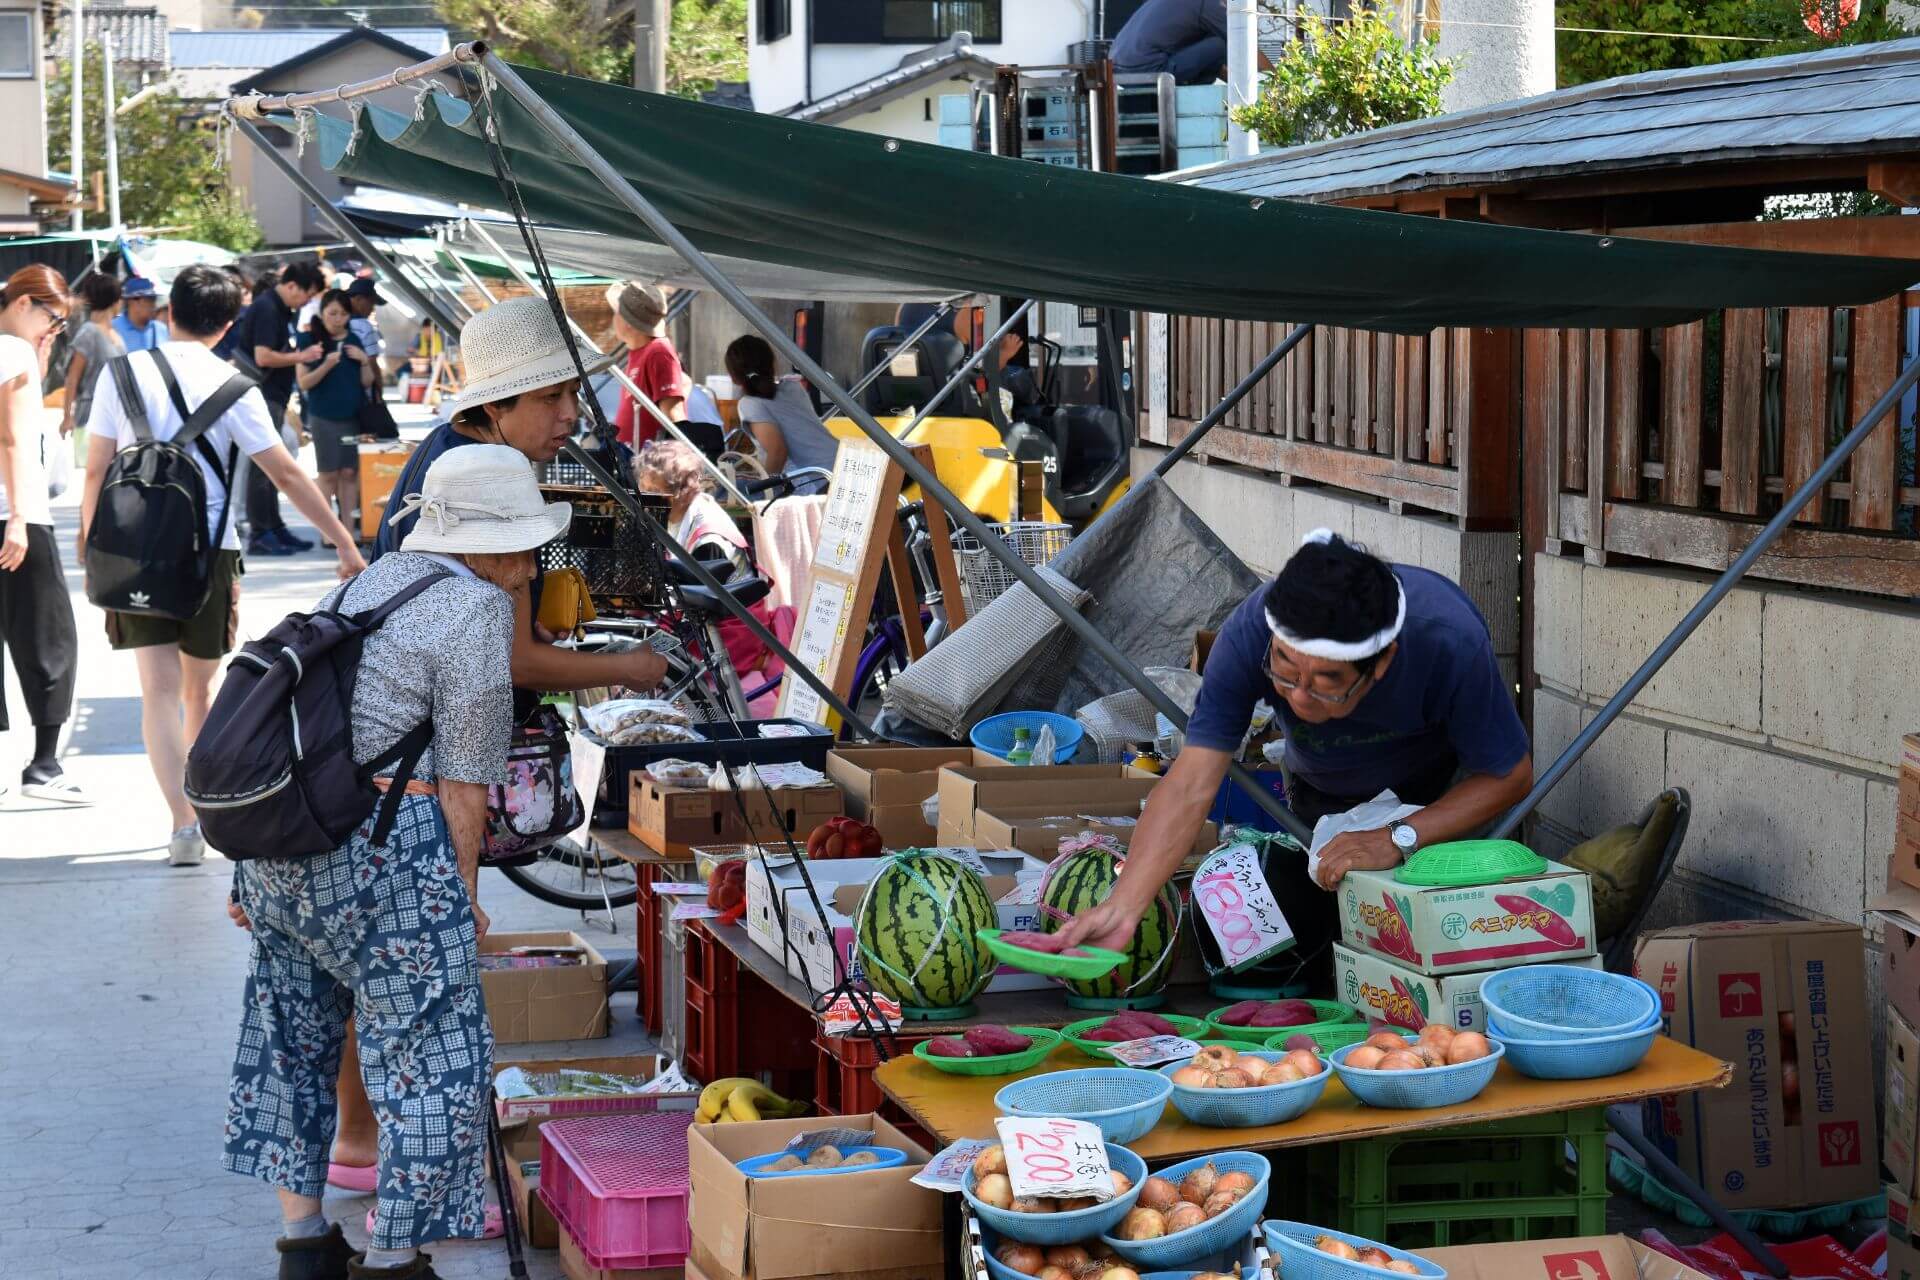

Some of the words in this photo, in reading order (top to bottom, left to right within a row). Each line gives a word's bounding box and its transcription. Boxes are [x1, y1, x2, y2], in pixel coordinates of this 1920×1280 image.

[1043, 455, 1057, 473] 25
[1469, 911, 1552, 933] ベニアズマ
[1458, 1009, 1473, 1027] S
[1745, 1029, 1773, 1168] ありがとうございます
[1015, 1132, 1075, 1182] 200
